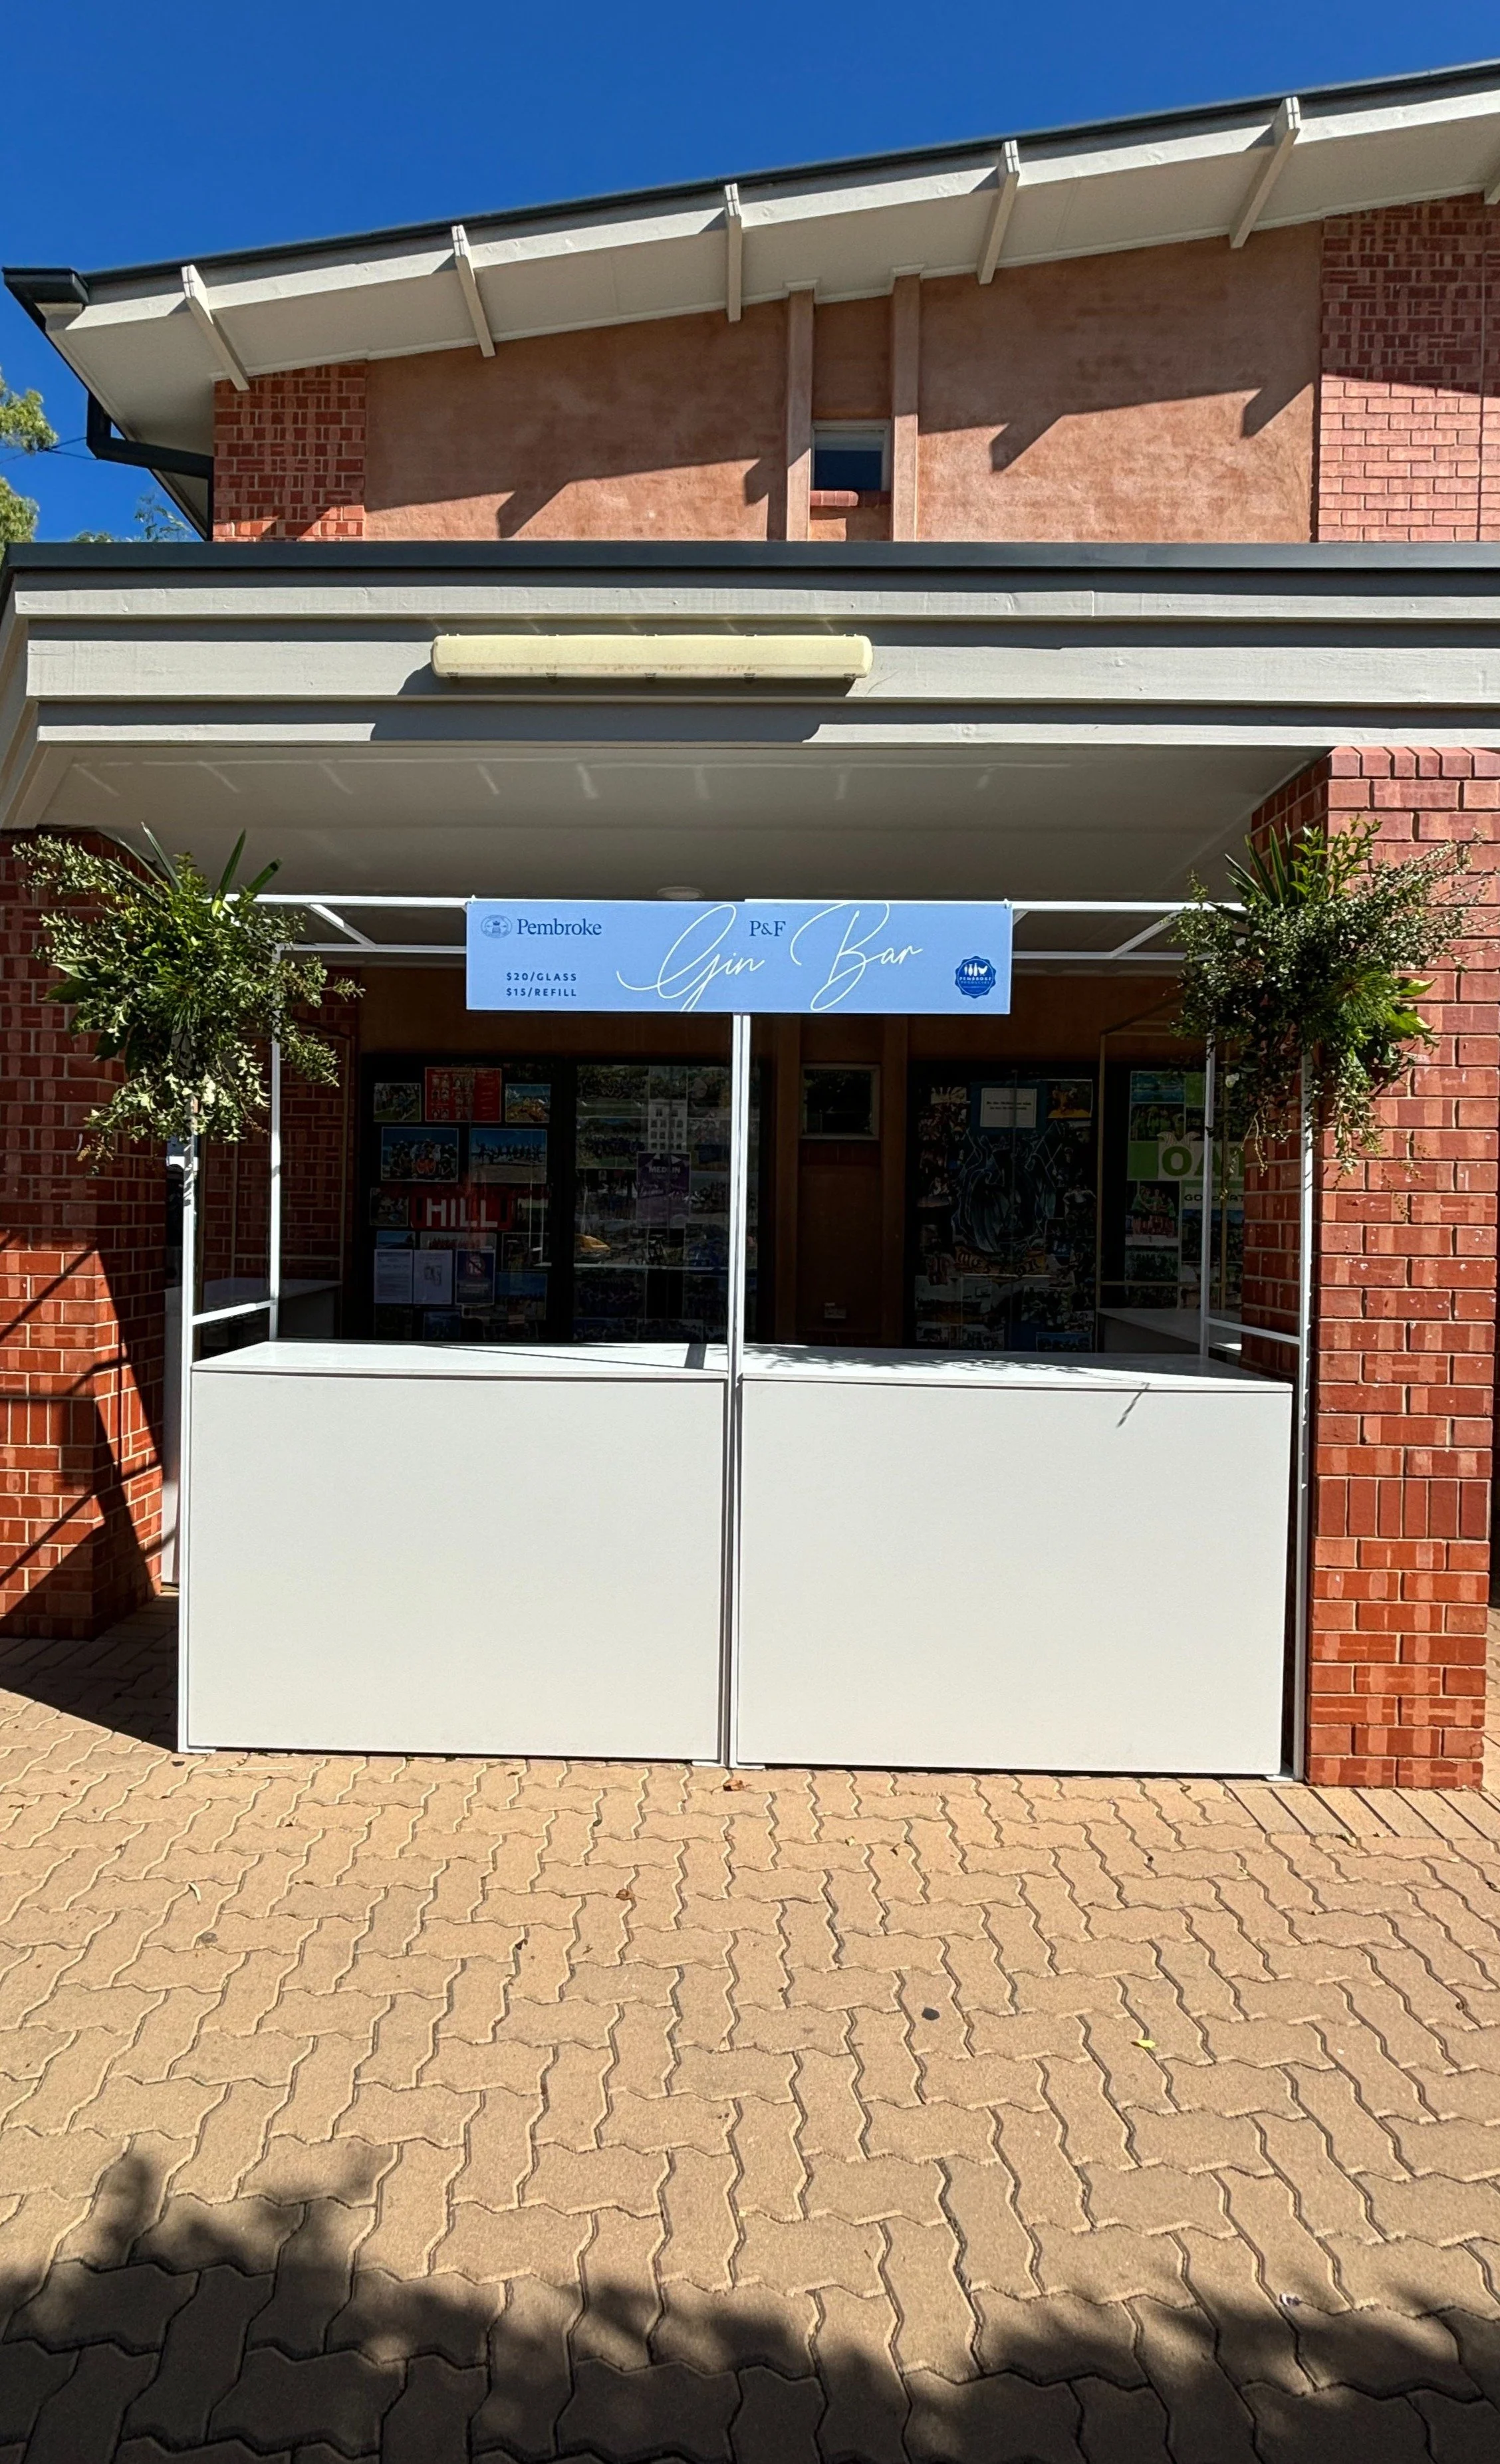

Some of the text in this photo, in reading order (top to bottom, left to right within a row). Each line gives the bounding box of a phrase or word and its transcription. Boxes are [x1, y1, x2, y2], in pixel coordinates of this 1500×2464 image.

[517, 918, 602, 935] Pembroke
[749, 921, 786, 937] P&F
[616, 903, 923, 1012] Gin Bar
[507, 971, 576, 982] $20/GLASS
[506, 987, 576, 997] $15/REFILL
[426, 1197, 498, 1228] HILL
